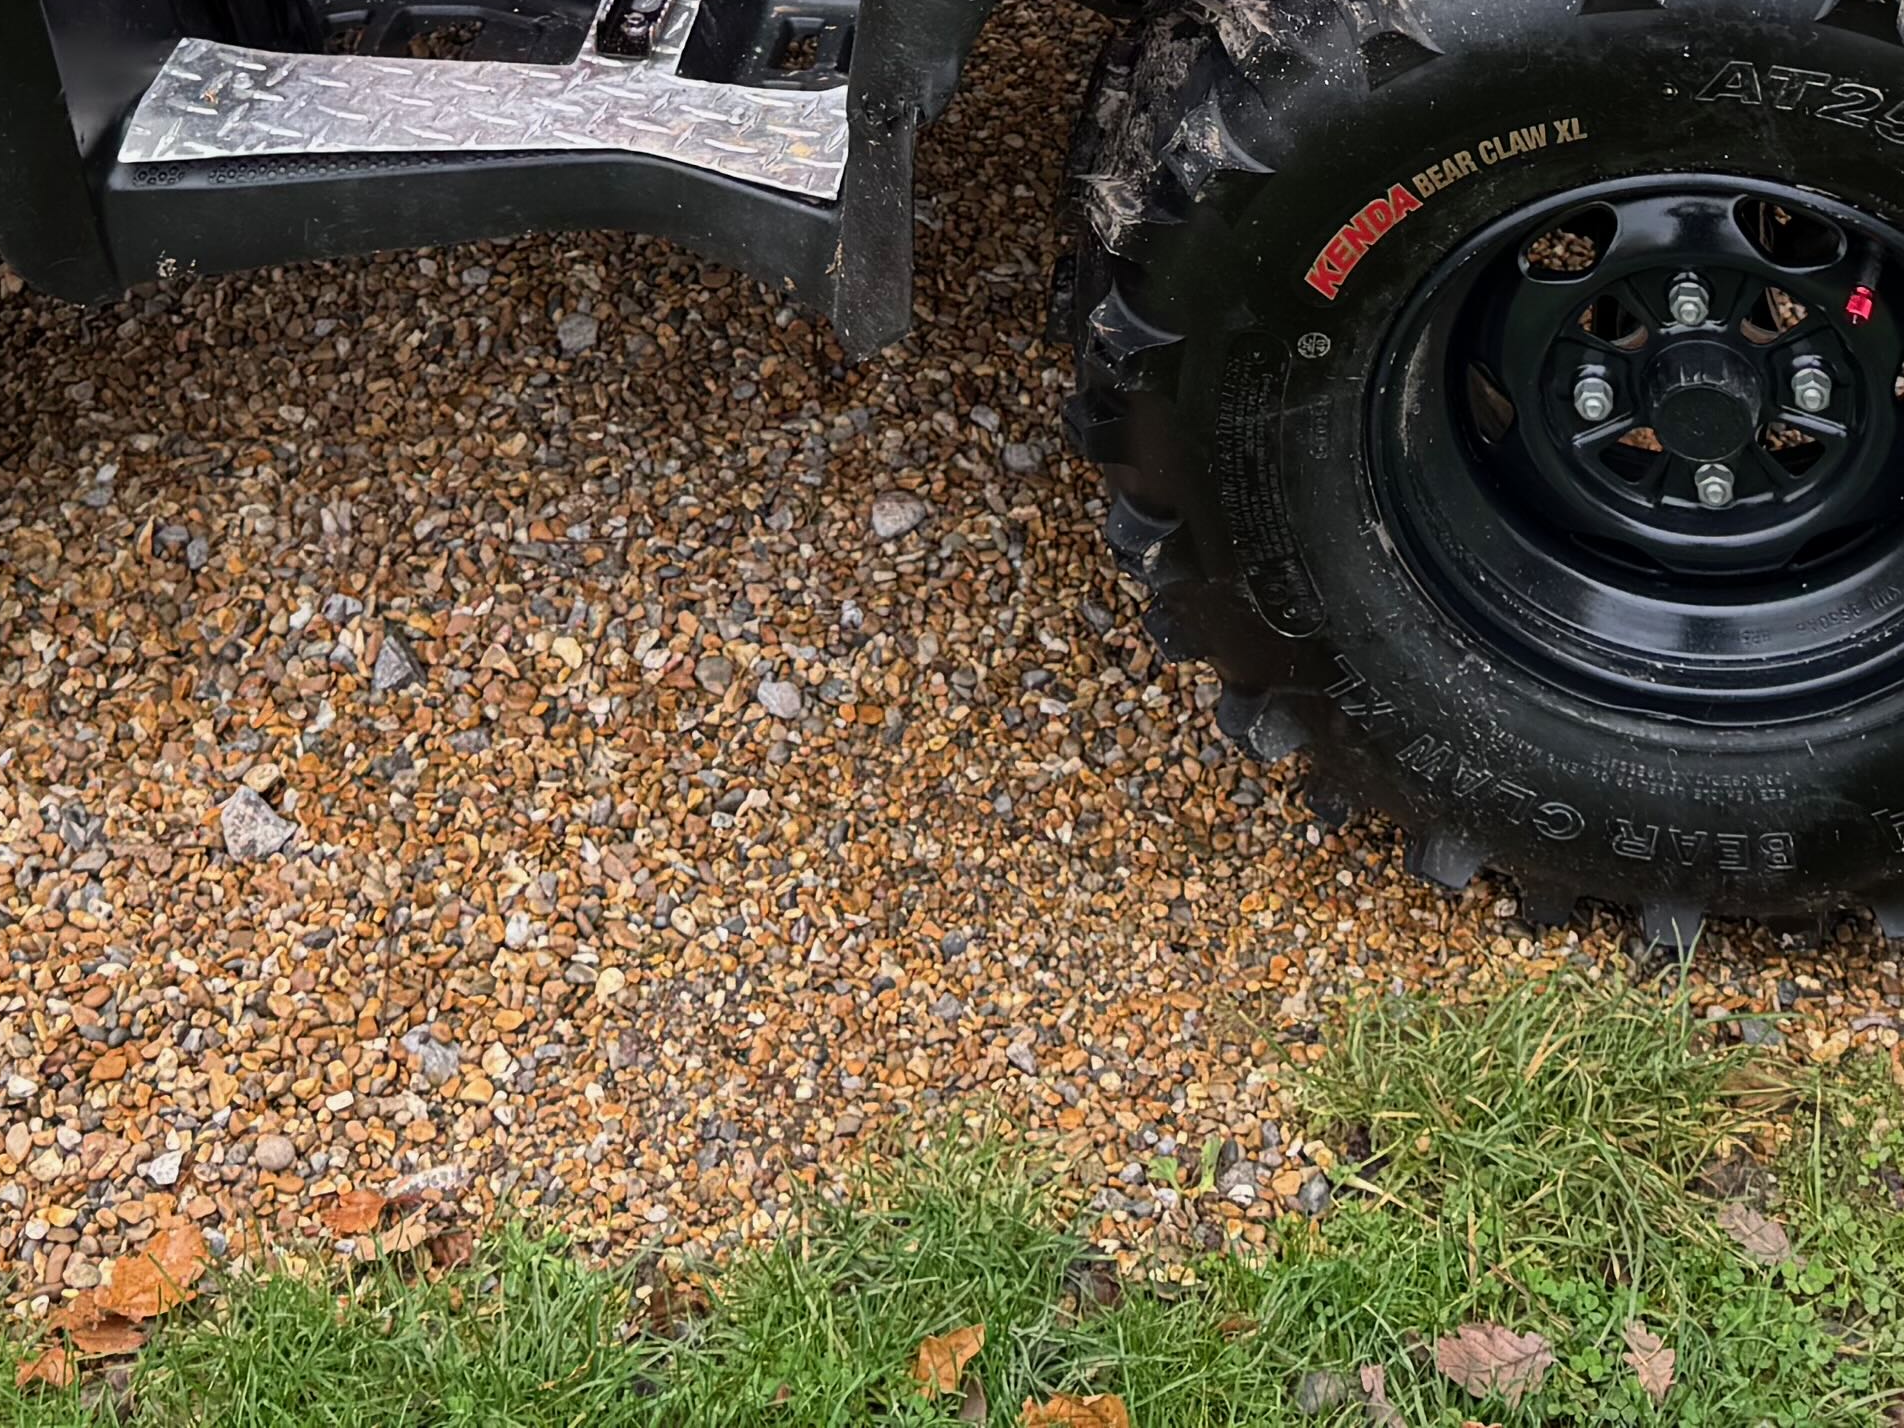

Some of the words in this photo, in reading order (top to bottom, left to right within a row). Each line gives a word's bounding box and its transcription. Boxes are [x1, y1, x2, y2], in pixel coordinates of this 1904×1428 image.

[1304, 182, 1424, 301] KENDA
[1411, 149, 1483, 199] BEAR
[1477, 123, 1547, 165] CLAW
[1552, 117, 1589, 144] XL
[1395, 732, 1589, 844] CLAW
[1610, 816, 1796, 874] BEAR
